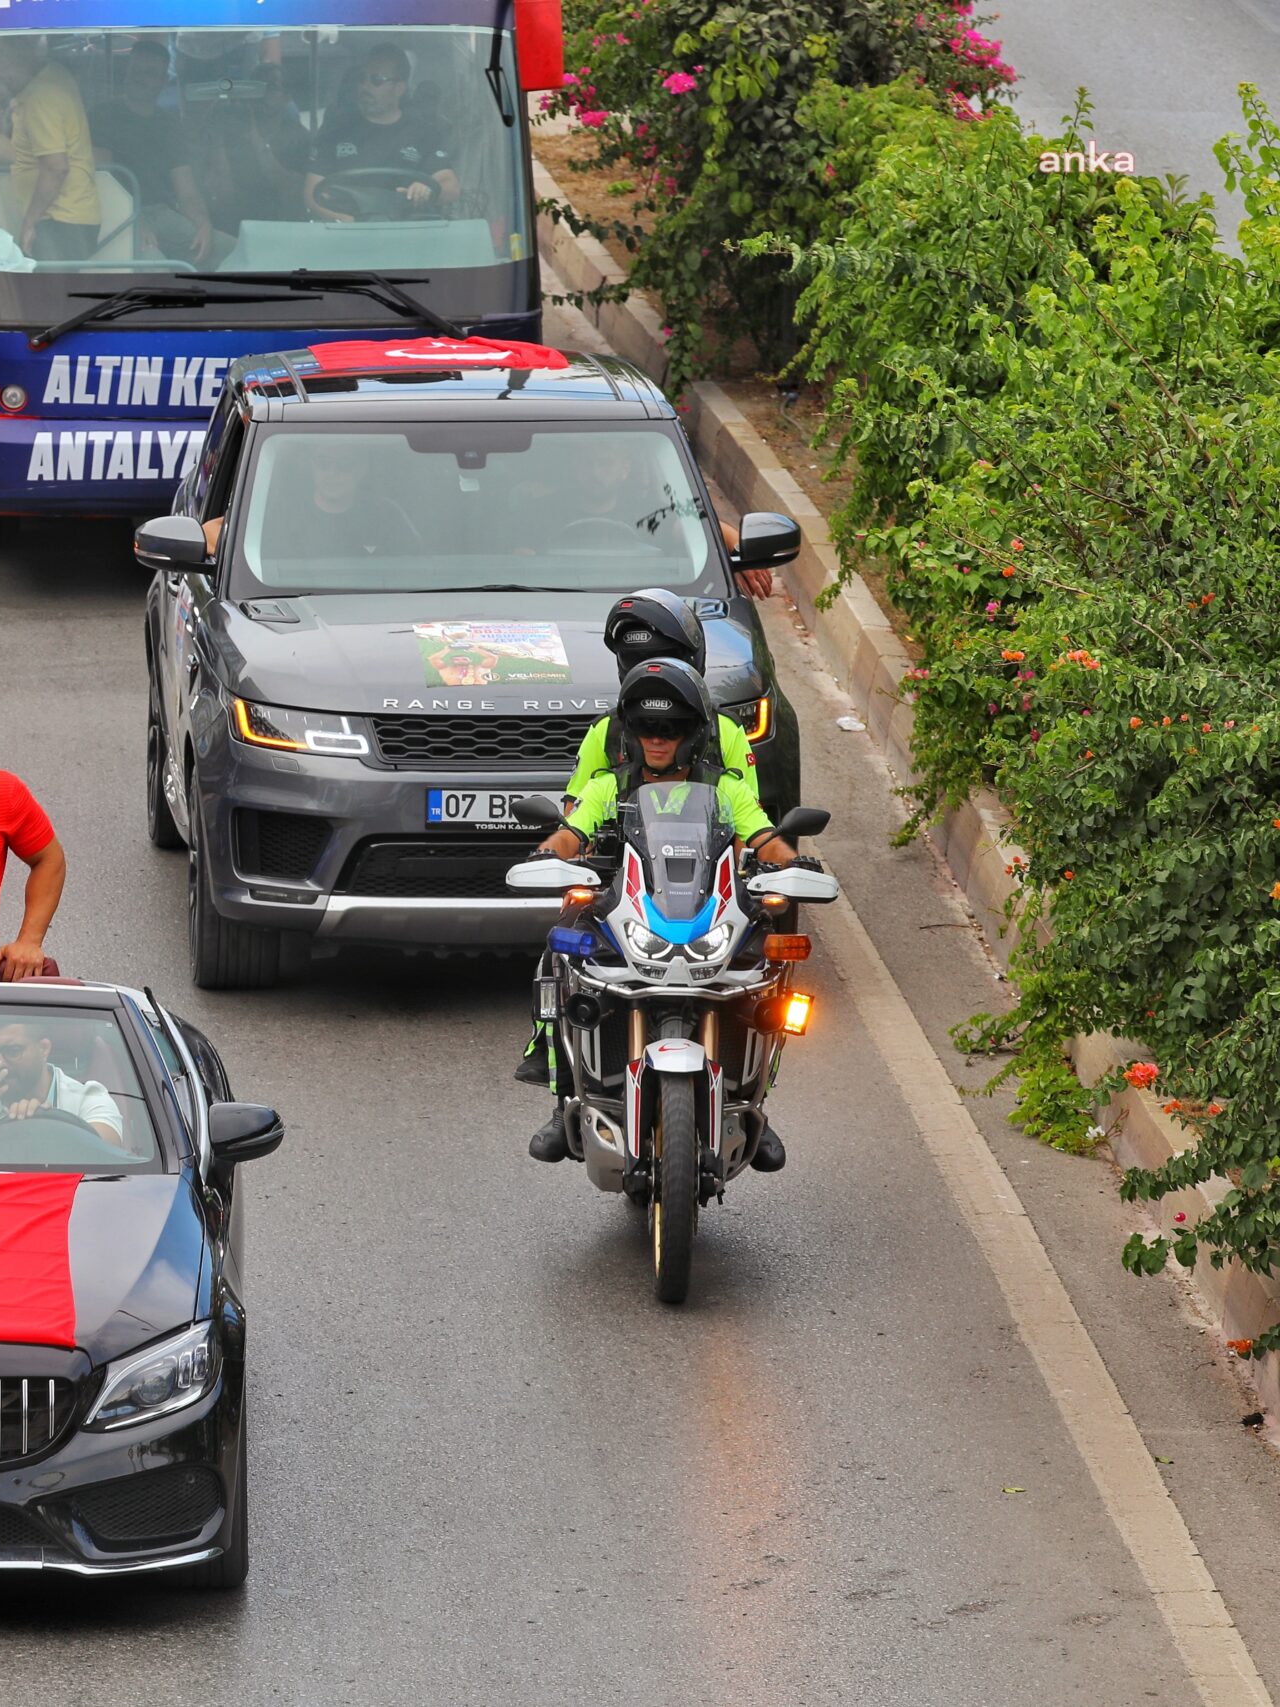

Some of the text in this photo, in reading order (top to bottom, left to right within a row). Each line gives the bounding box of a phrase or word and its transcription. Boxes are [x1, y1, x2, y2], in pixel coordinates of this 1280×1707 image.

[42, 355, 238, 407] ALTIN KE
[626, 632, 648, 642] SHOEI
[383, 698, 619, 710] RANGE ROVE
[644, 699, 669, 708] SHOEI
[431, 807, 441, 815] TR
[445, 794, 476, 819] 07
